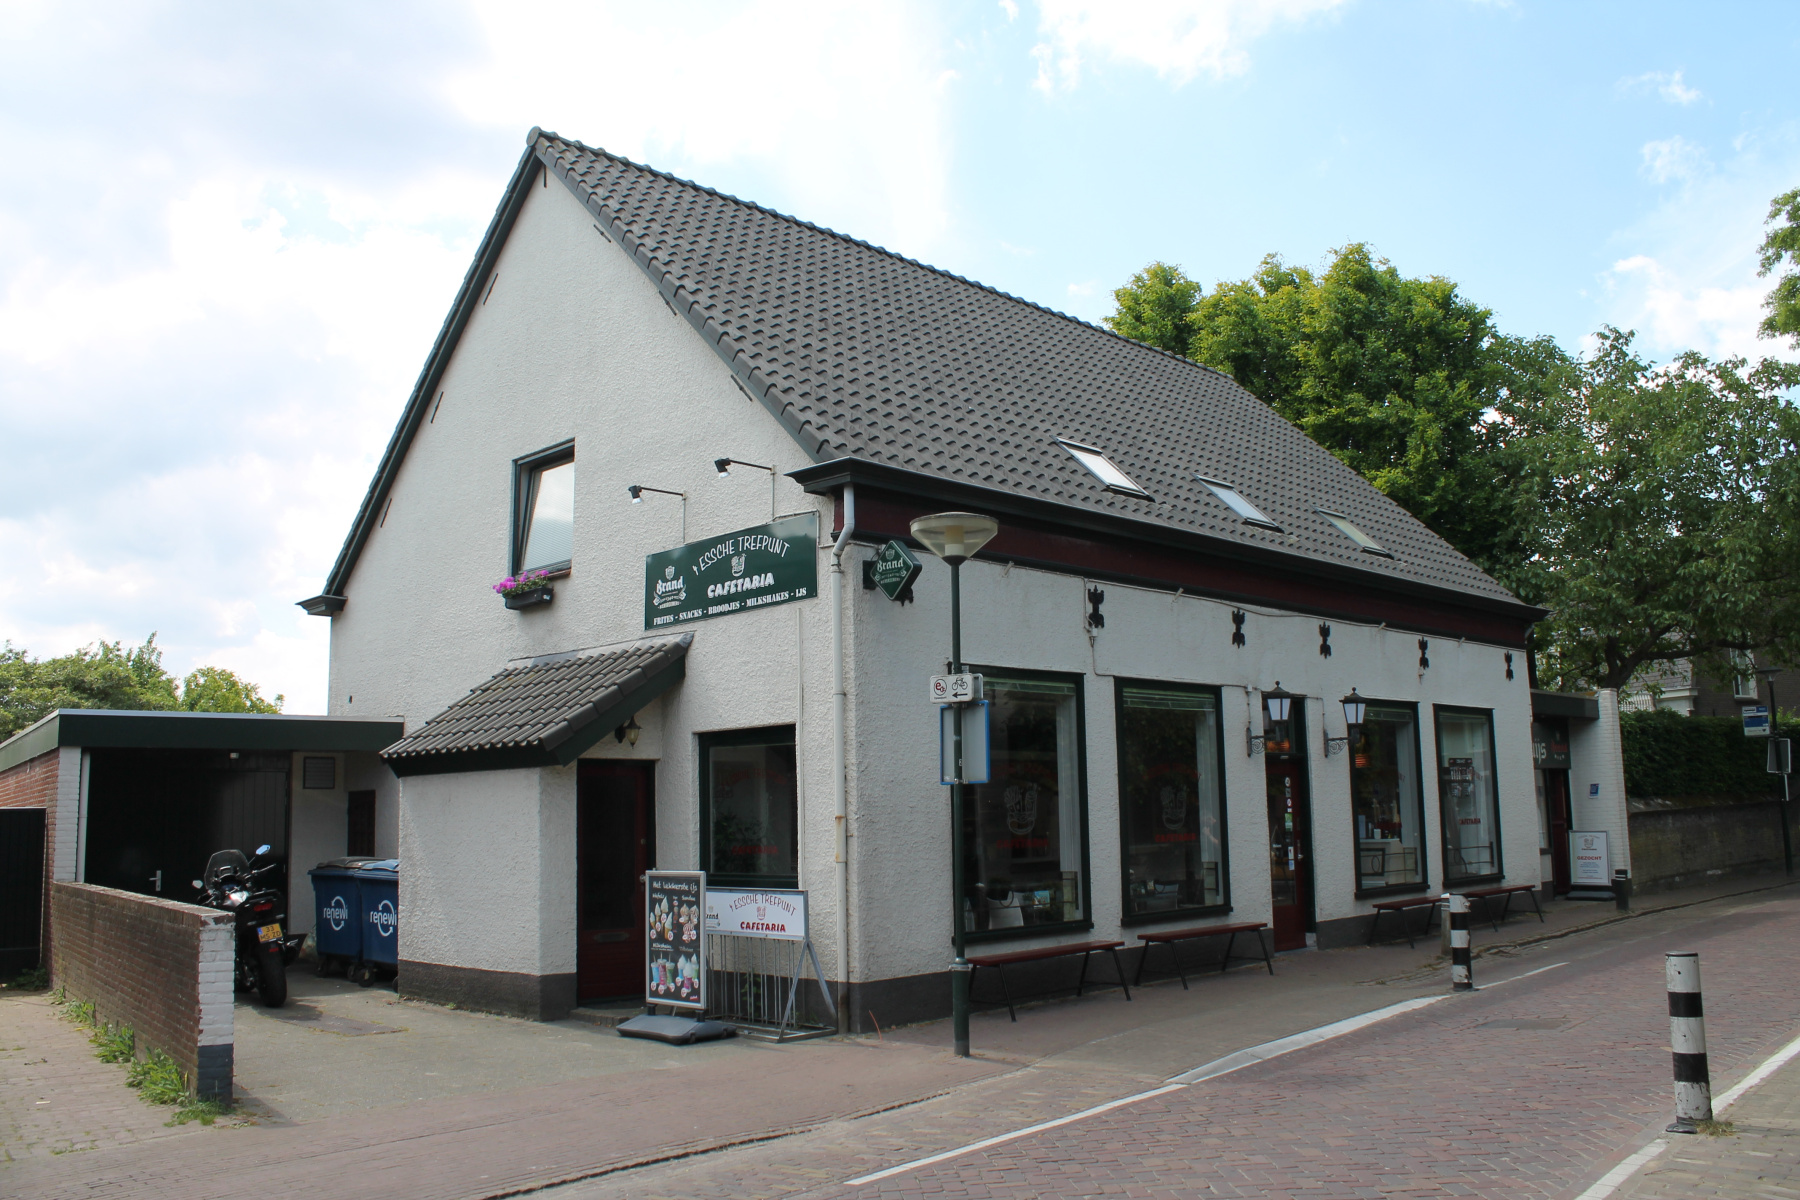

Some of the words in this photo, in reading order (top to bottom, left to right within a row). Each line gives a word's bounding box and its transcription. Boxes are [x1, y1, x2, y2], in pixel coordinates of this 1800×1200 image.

[698, 539, 735, 572] ESSCHE
[737, 534, 791, 558] TREFPUNT
[877, 557, 904, 573] Brand
[656, 575, 684, 595] Brand
[707, 572, 775, 599] CAFETARIA
[653, 614, 674, 626] FRITES
[679, 608, 703, 621] SNACKS
[708, 600, 740, 615] BROODJES
[746, 591, 789, 608] MILKSHAKES
[795, 587, 807, 598] IJS
[652, 881, 661, 889] Het
[323, 906, 348, 920] renewi
[733, 894, 759, 910] ESSCHE
[761, 893, 797, 916] TREFPUNT
[370, 909, 397, 926] renewi
[265, 925, 275, 933] 33
[740, 921, 786, 933] CAFETARIA
